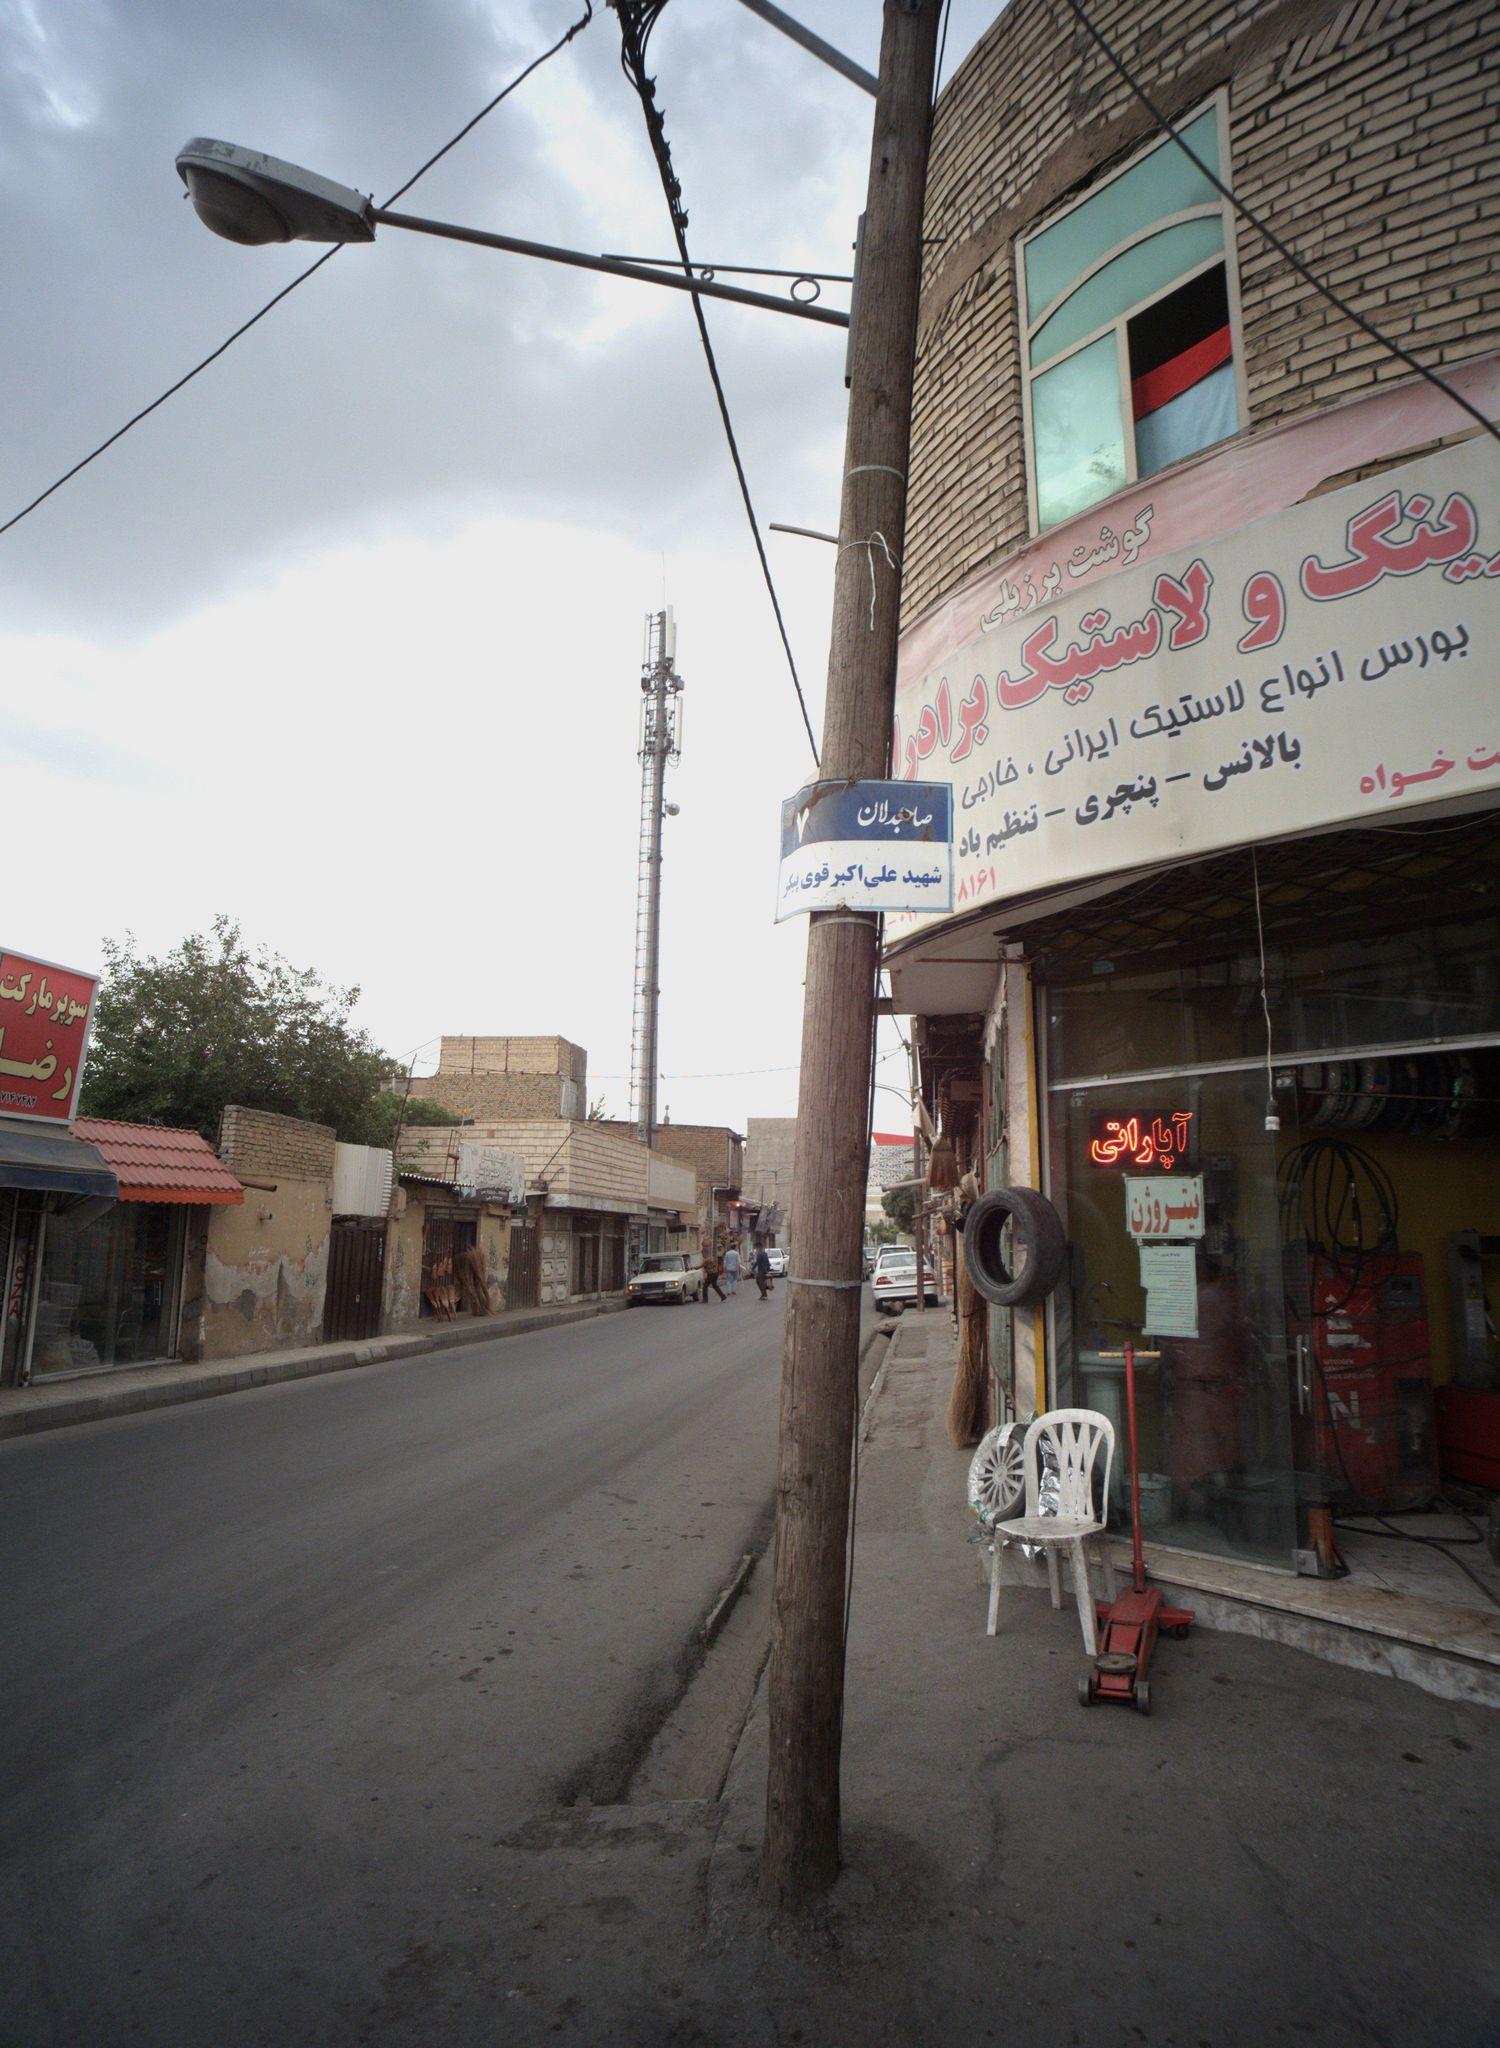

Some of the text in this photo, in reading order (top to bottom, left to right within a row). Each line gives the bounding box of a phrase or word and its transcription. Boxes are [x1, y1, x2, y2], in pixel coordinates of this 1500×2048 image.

[1067, 503, 1155, 579] گوشت
[886, 489, 1500, 781] ینگ و لاستیک برادرا
[961, 623, 1470, 810] بورس انواع لاستیک ایرانی خارجی
[958, 731, 1302, 858] بالانس پنچری تنظیم باد
[1359, 749, 1456, 798] خواه
[801, 862, 830, 889] قوی
[902, 865, 942, 888] شهید
[1091, 1112, 1193, 1169] آپاراتی
[1131, 1181, 1200, 1233] نیتروژن
